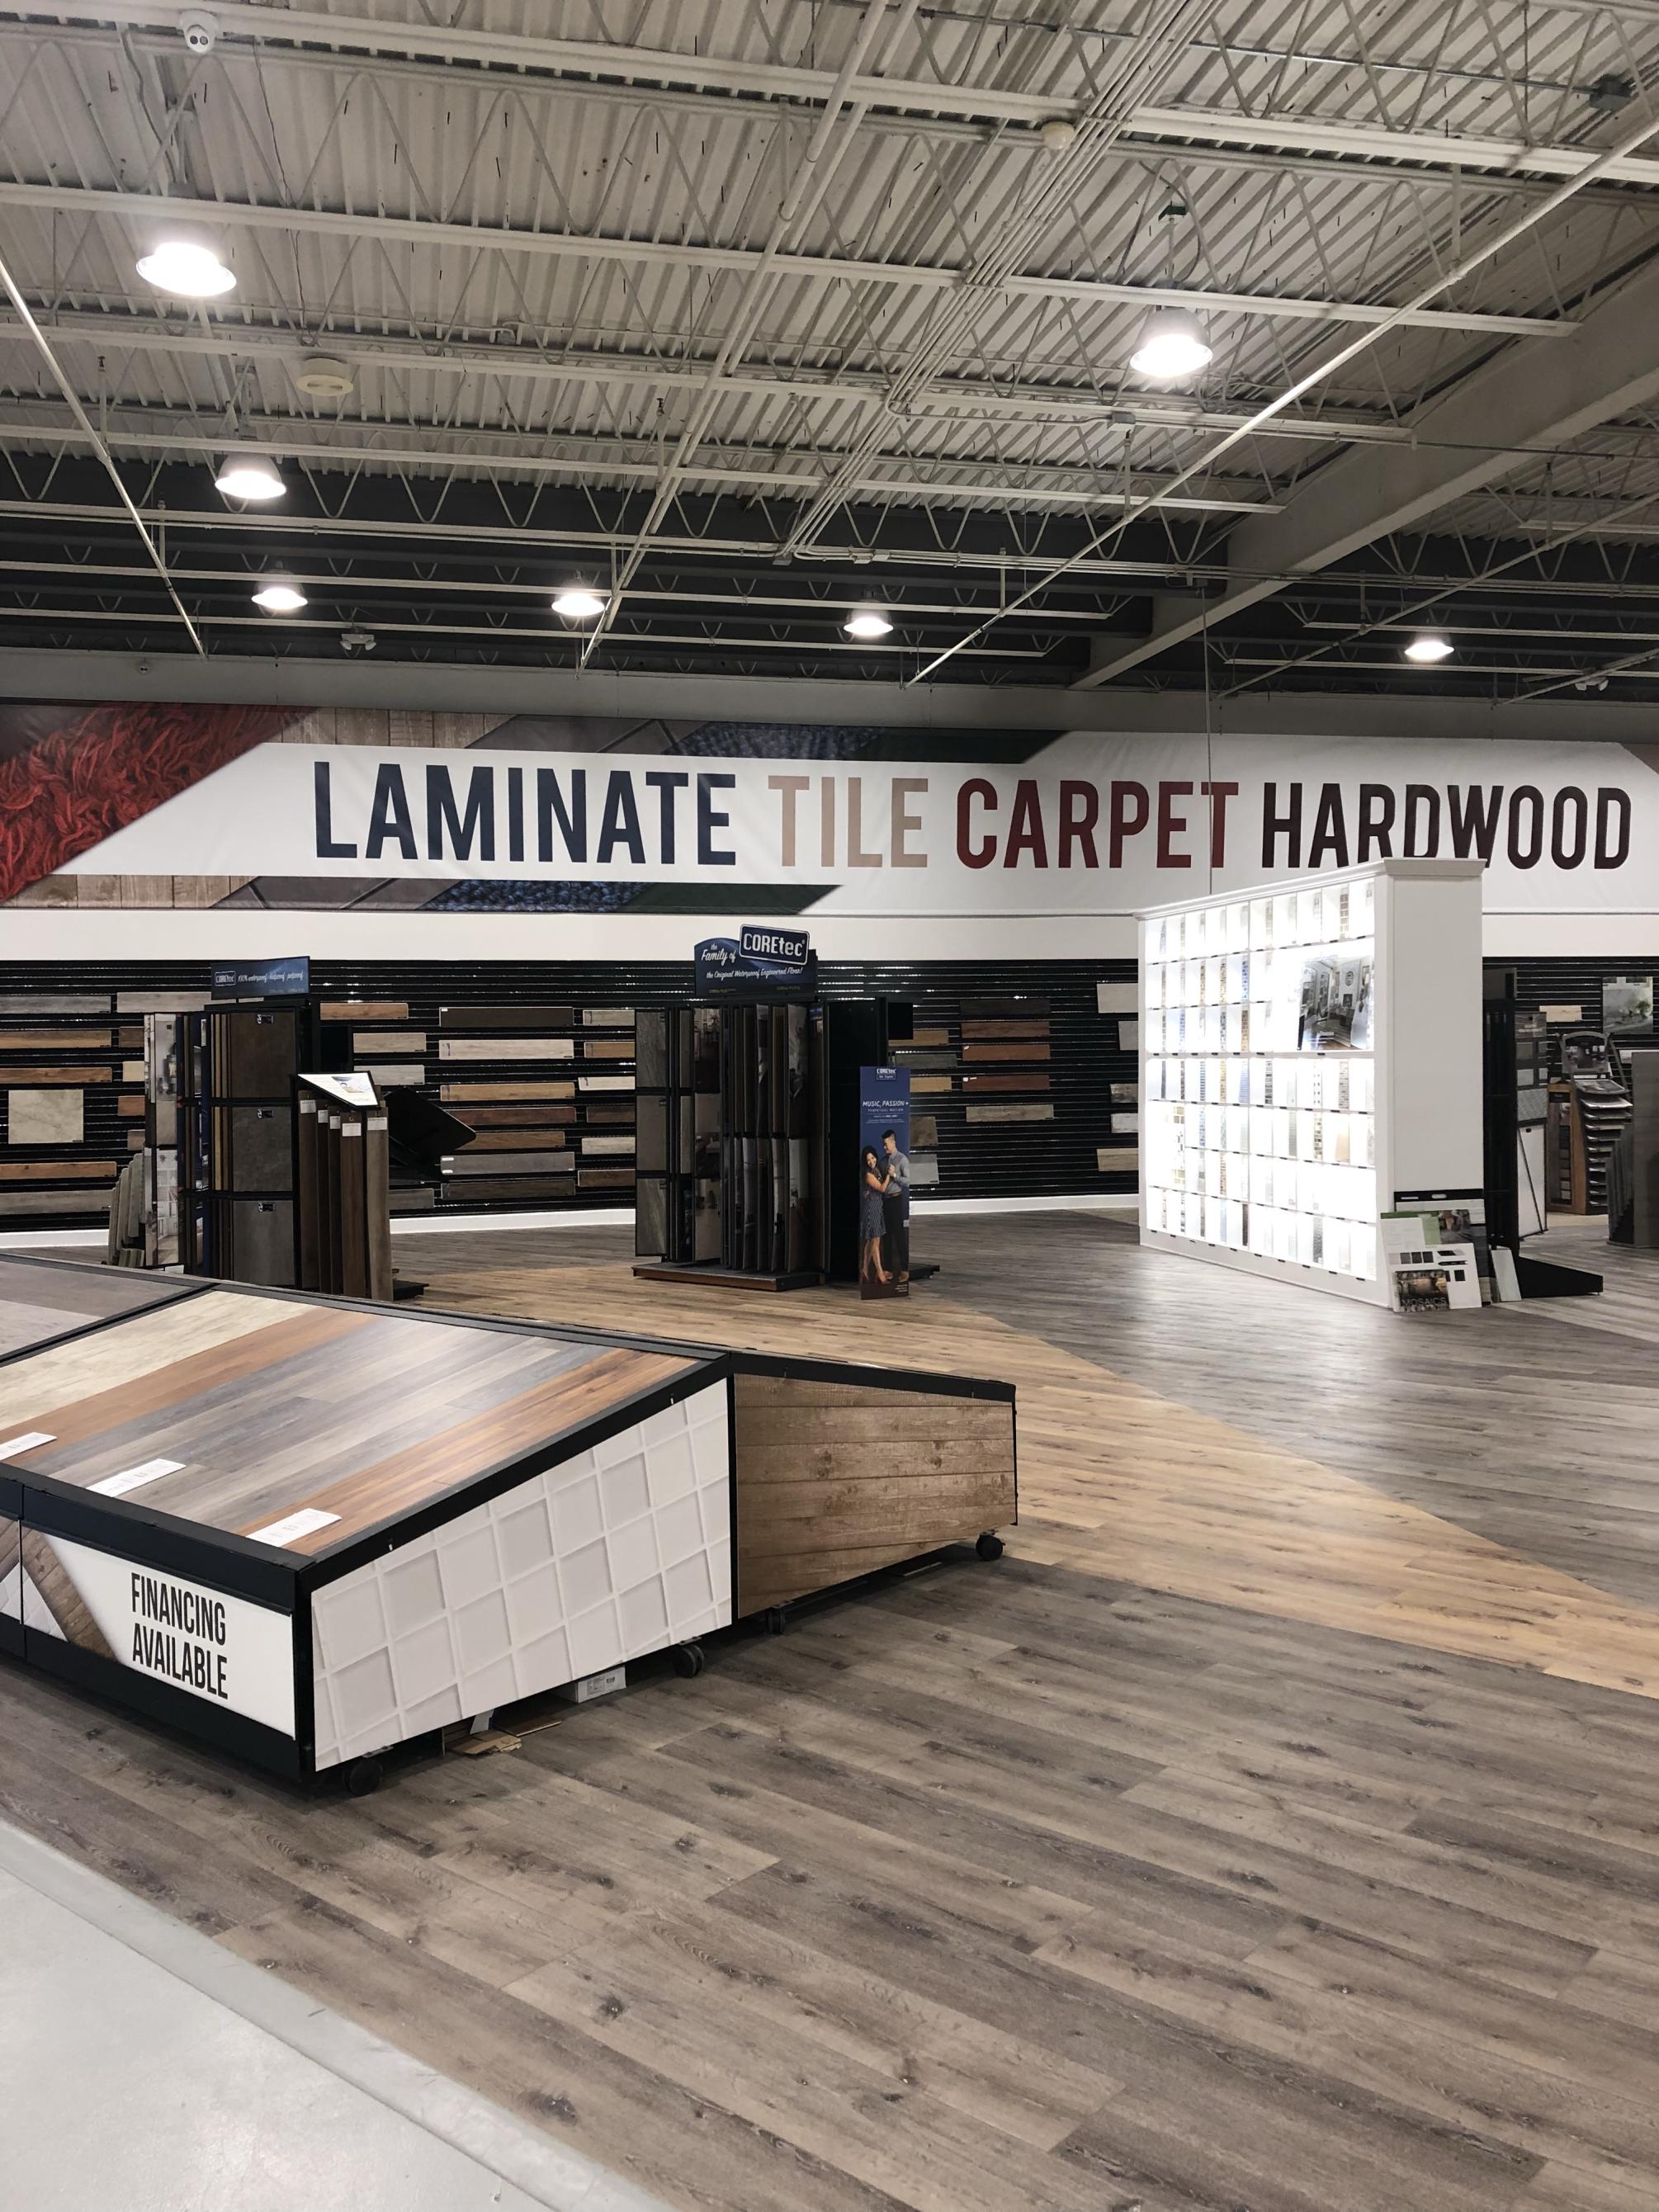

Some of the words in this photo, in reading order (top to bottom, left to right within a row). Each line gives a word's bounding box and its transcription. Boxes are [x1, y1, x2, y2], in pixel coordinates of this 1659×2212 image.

[314, 761, 736, 866] LAMINATE
[768, 775, 929, 867] TILE
[957, 778, 1239, 869] CARPET
[1261, 782, 1632, 870] HARDWOOD
[743, 933, 803, 957] COREtec
[701, 948, 728, 967] Family
[728, 949, 736, 963] of
[714, 970, 734, 981] Original
[1401, 1297, 1447, 1307] MOSAICS
[130, 1572, 226, 1646] FINANCING
[132, 1622, 229, 1699] AVAILABLE
